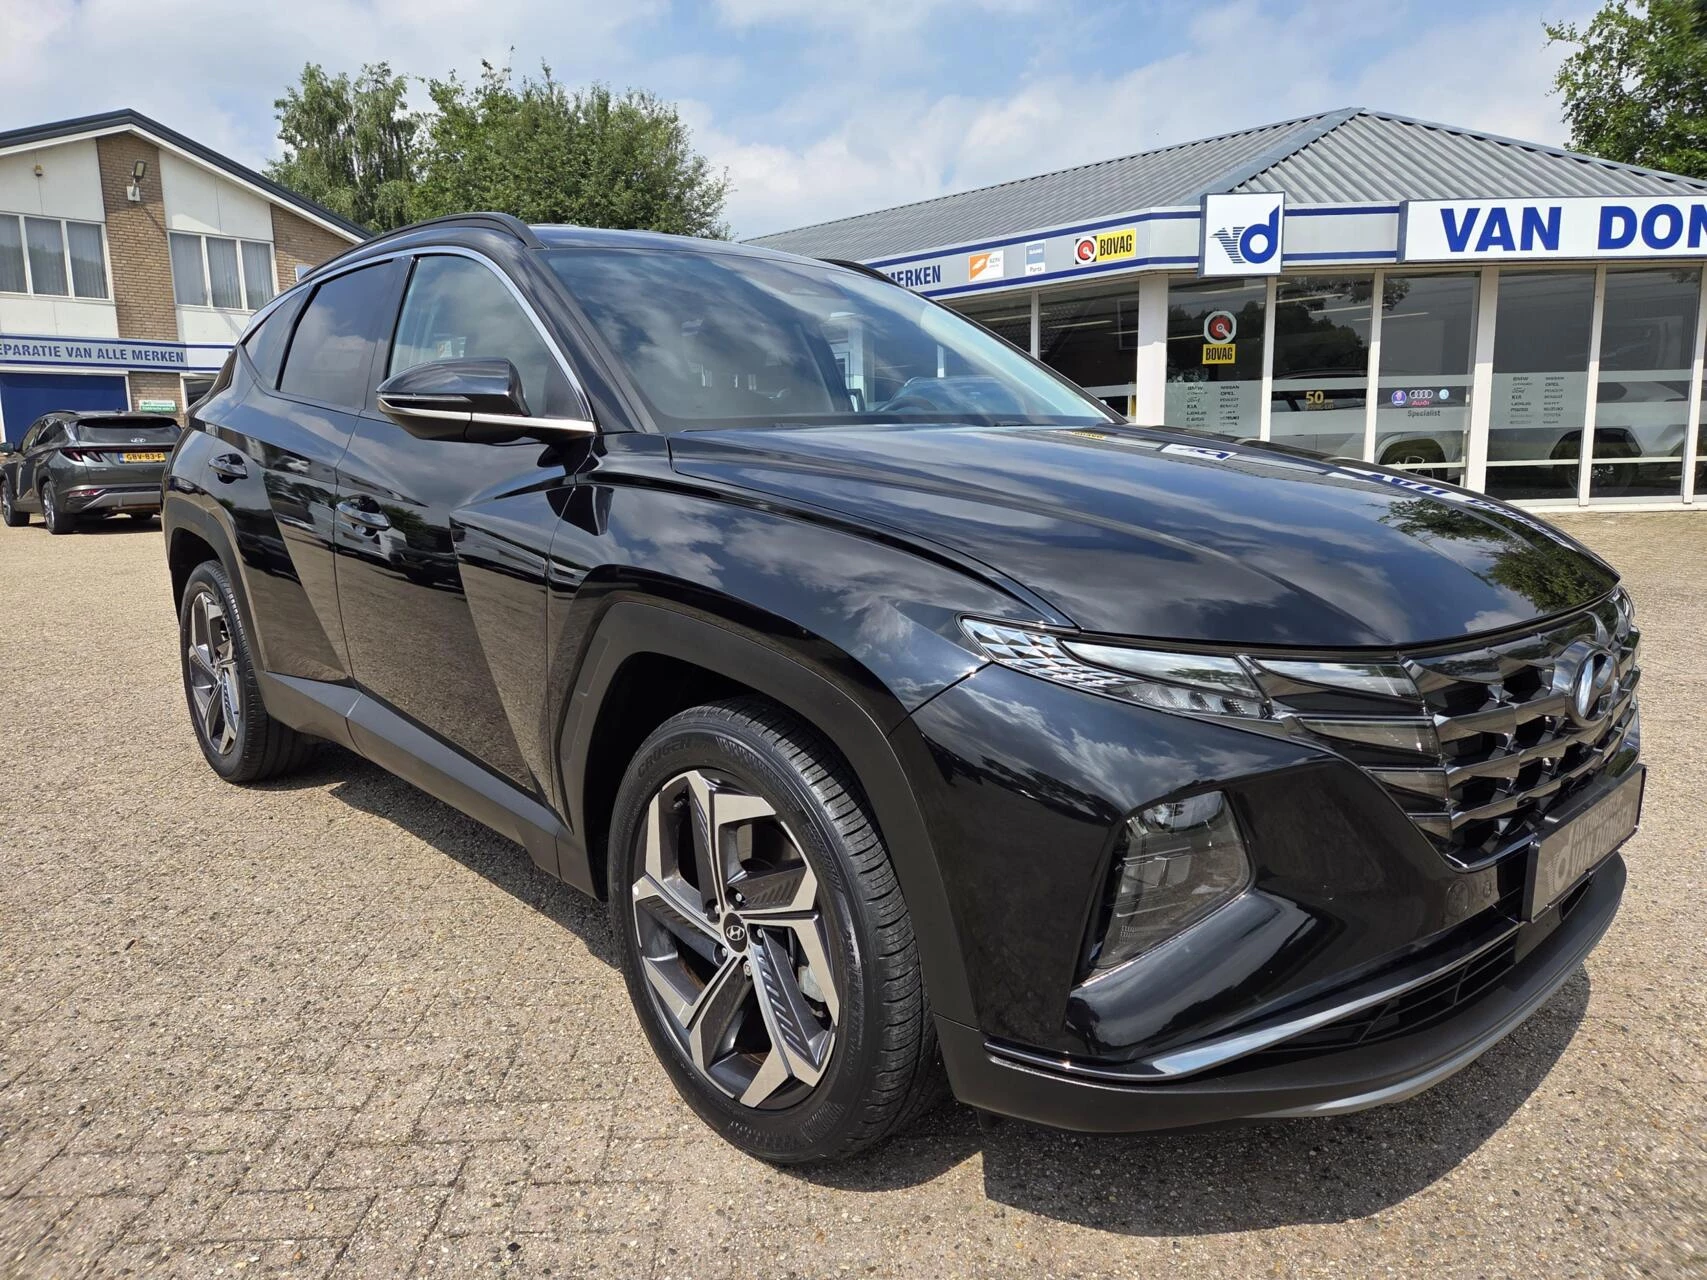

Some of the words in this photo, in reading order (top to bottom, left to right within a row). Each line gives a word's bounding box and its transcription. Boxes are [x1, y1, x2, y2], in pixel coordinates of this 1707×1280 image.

[1440, 206, 1562, 253] VAN
[1099, 234, 1133, 257] BOVAG
[65, 346, 92, 359] VAN
[97, 348, 127, 360] ALLE
[132, 350, 184, 363] MERKEN
[1206, 347, 1233, 361] BOVAG
[1305, 391, 1324, 405] 50
[1407, 409, 1441, 418] Specialist
